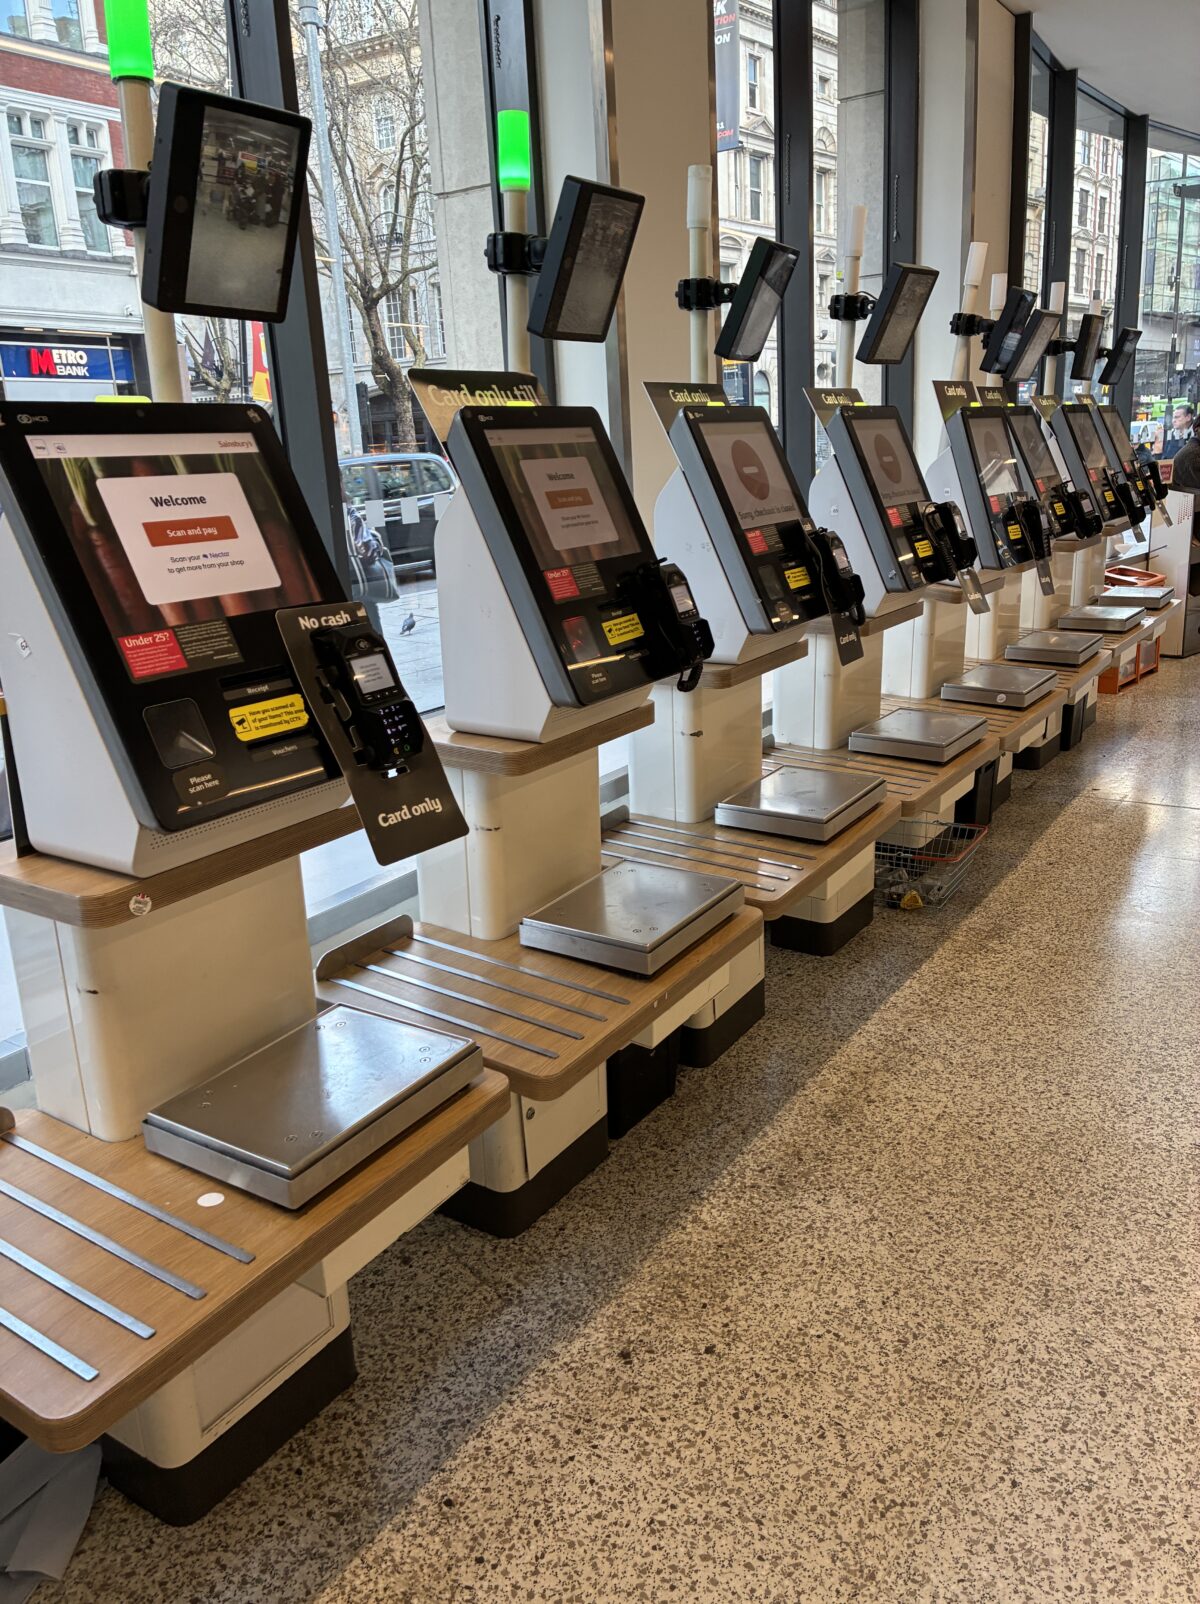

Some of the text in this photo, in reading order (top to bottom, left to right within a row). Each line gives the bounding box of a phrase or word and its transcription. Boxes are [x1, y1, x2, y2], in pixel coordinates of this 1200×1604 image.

[29, 347, 88, 376] METRO
[57, 365, 90, 376] BANK
[427, 383, 474, 406] Card
[512, 384, 542, 406] till
[668, 388, 691, 402] Card
[149, 495, 207, 508] Welcome
[166, 526, 218, 538] Scan and pay
[175, 565, 186, 574] get
[230, 558, 245, 567] shop
[187, 555, 201, 563] your
[298, 611, 351, 630] No cash
[124, 631, 170, 648] Under 25?
[246, 684, 269, 694] Receipt
[188, 778, 220, 794] scan here
[189, 773, 213, 785] Please
[377, 797, 444, 828] Card only
